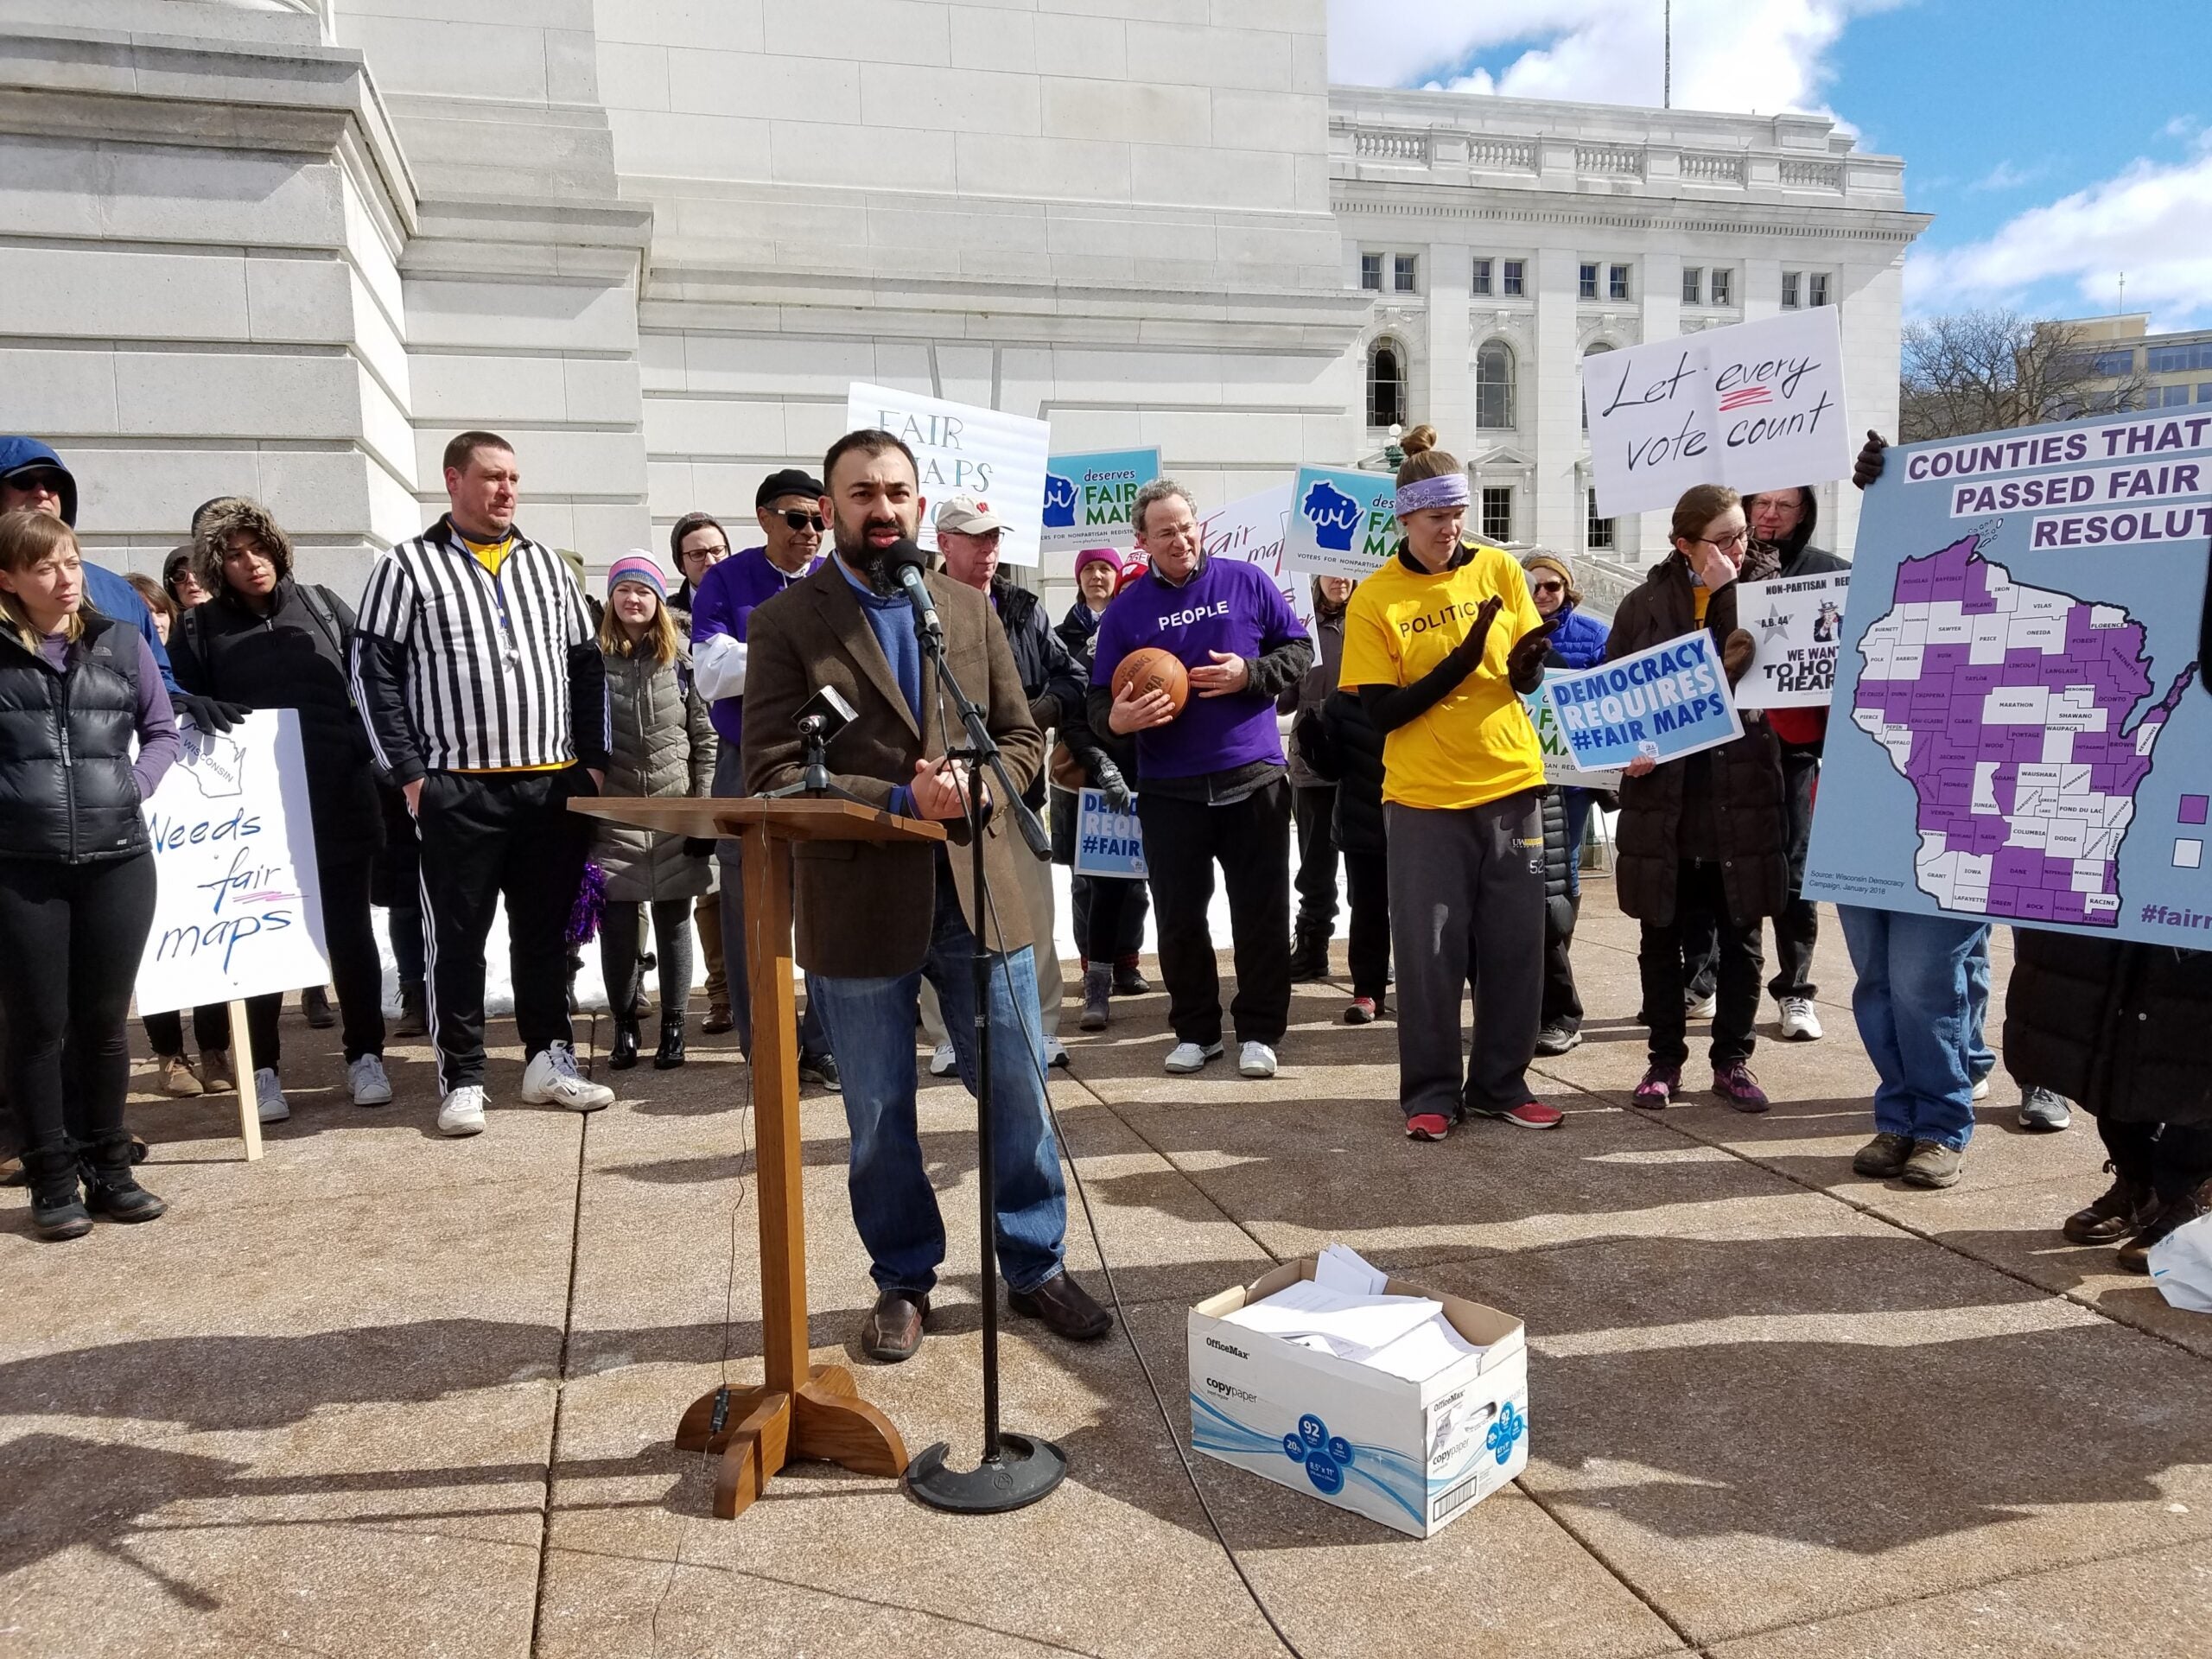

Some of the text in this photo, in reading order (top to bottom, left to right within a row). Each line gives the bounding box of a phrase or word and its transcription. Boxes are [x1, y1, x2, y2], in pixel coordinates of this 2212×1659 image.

[1603, 351, 1821, 417] Let every
[878, 410, 963, 450] FAIR
[1627, 391, 1834, 471] vote count
[1909, 417, 2212, 480] COUNTIES THAT
[914, 457, 994, 493] APS
[1084, 469, 1135, 482] deserves
[1085, 483, 1138, 505] FAIR
[1956, 464, 2200, 514] PASSED FAIR
[1199, 511, 1256, 556] Fair
[1765, 580, 1827, 595] NON-PARTISAN
[1159, 601, 1230, 631] PEOPLE
[1777, 615, 1789, 626] 44
[1787, 649, 1804, 661] WE
[2112, 646, 2139, 677] MARINETTE
[1553, 639, 1707, 706] DEMOCRACY
[1764, 663, 1794, 679] TO
[1562, 664, 1716, 730] REQUIRES
[1571, 720, 1647, 751] #FAIR
[1652, 693, 1725, 734] MAPS
[2138, 726, 2158, 753] KEWAUNEE
[183, 738, 234, 783] WISCONSIN
[2062, 769, 2091, 790] WINNEBAGO
[2016, 789, 2040, 812] MARQUETTE
[2107, 799, 2130, 827] SHEBOYGAN
[148, 807, 262, 855] Needs
[2083, 830, 2110, 859] WASHINGTON
[2108, 832, 2120, 855] OZAUKEE
[1083, 836, 1141, 857] #FAIR
[197, 846, 282, 915] fair
[1811, 870, 1905, 888] Source: Wisconsin Democracy
[1843, 884, 1868, 894] January
[1954, 895, 1986, 904] LAFAYETTE
[156, 910, 292, 975] maps
[1206, 1337, 1249, 1359] OfficeMax
[1206, 1377, 1257, 1403] copypaper
[1433, 1389, 1465, 1412] OfficeMax
[1303, 1421, 1319, 1438] 92
[1433, 1438, 1469, 1465] copypaper
